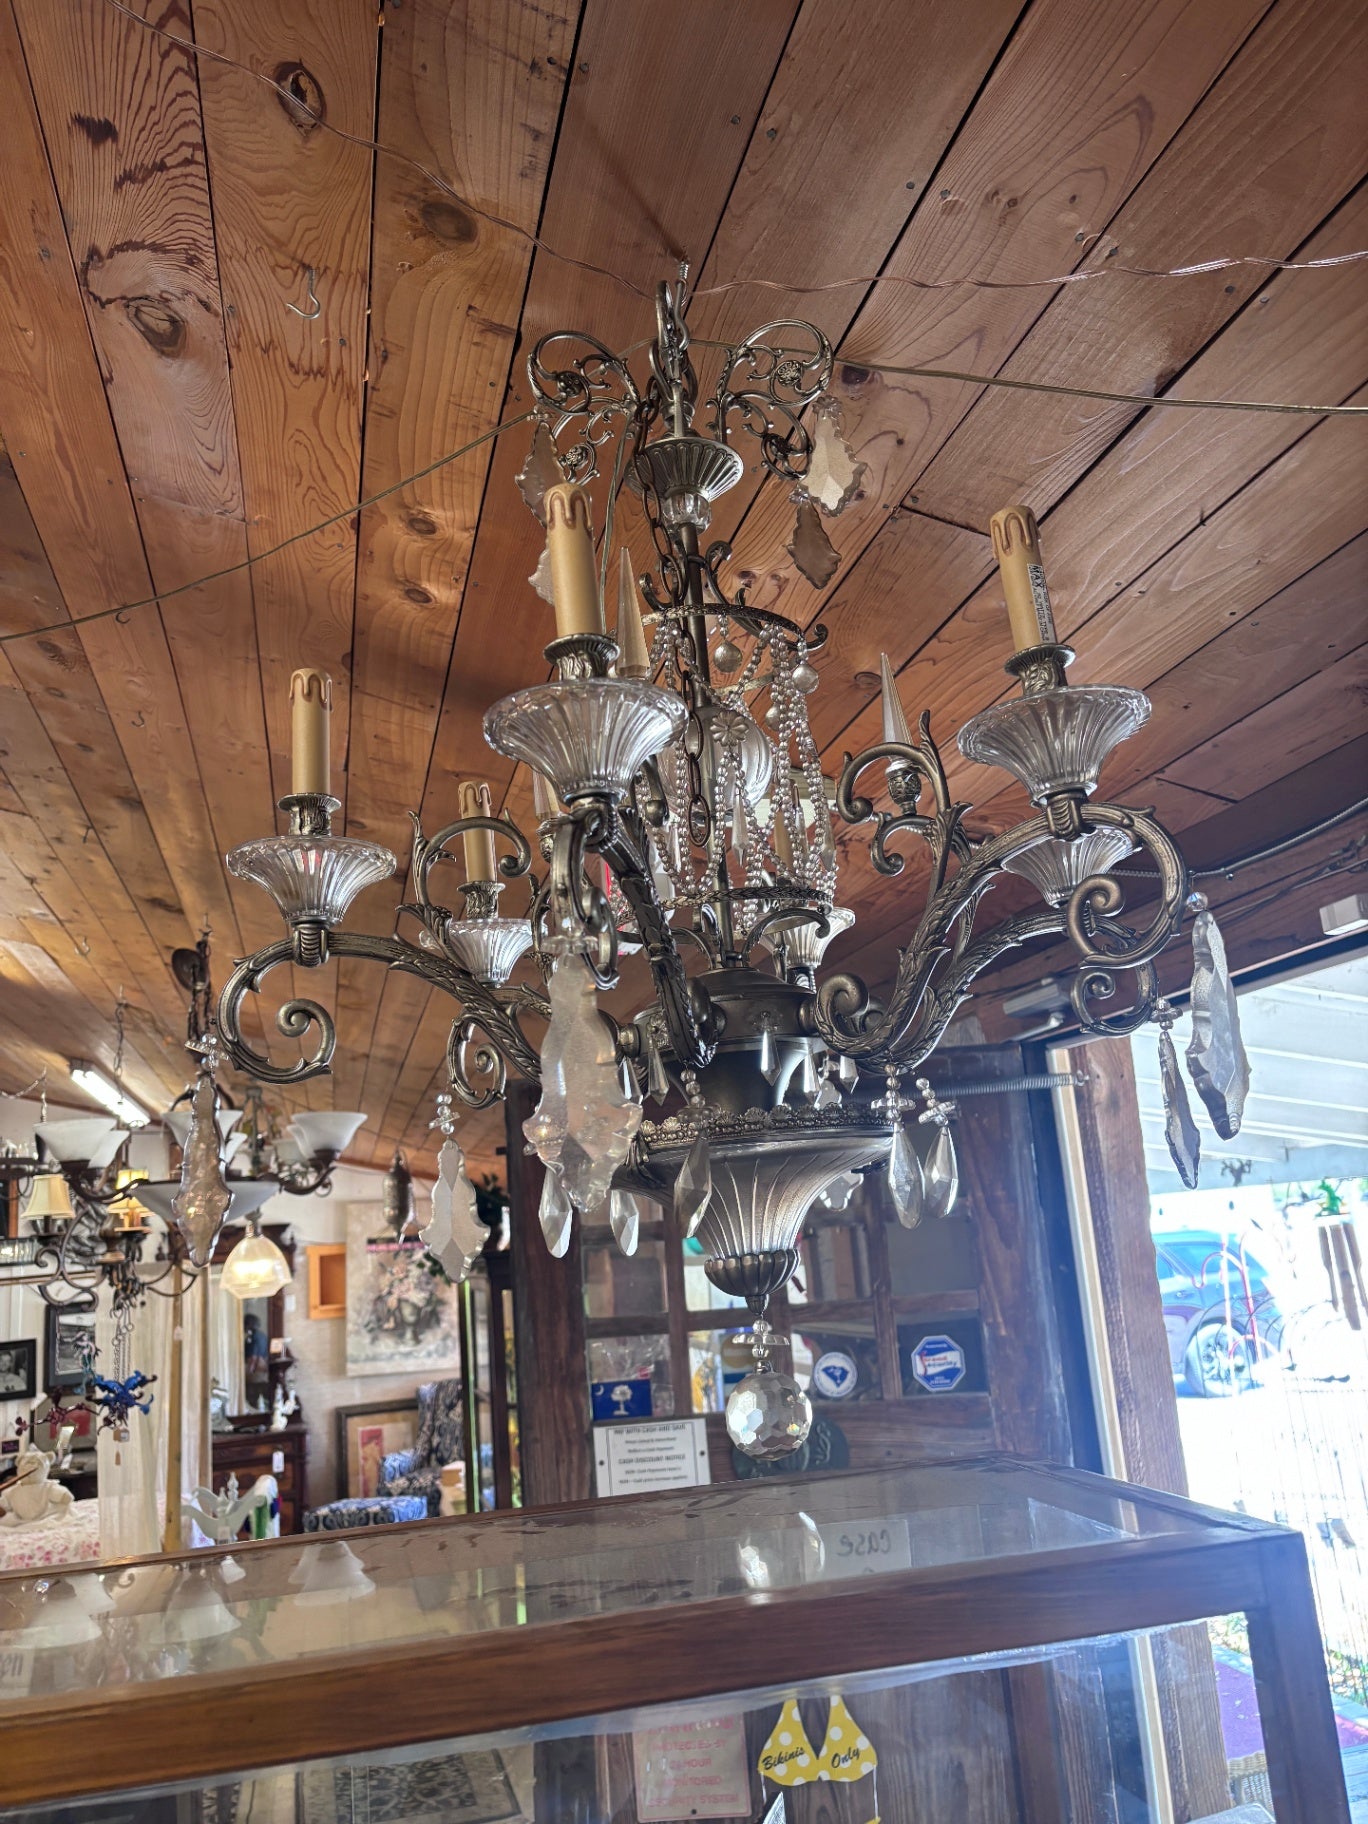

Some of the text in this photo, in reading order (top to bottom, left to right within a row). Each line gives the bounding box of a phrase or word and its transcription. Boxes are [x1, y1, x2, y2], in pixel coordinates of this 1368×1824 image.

[1032, 565, 1042, 588] MAX
[762, 1746, 860, 1770] Bikinis Only
[699, 1793, 739, 1804] SYSTEM
